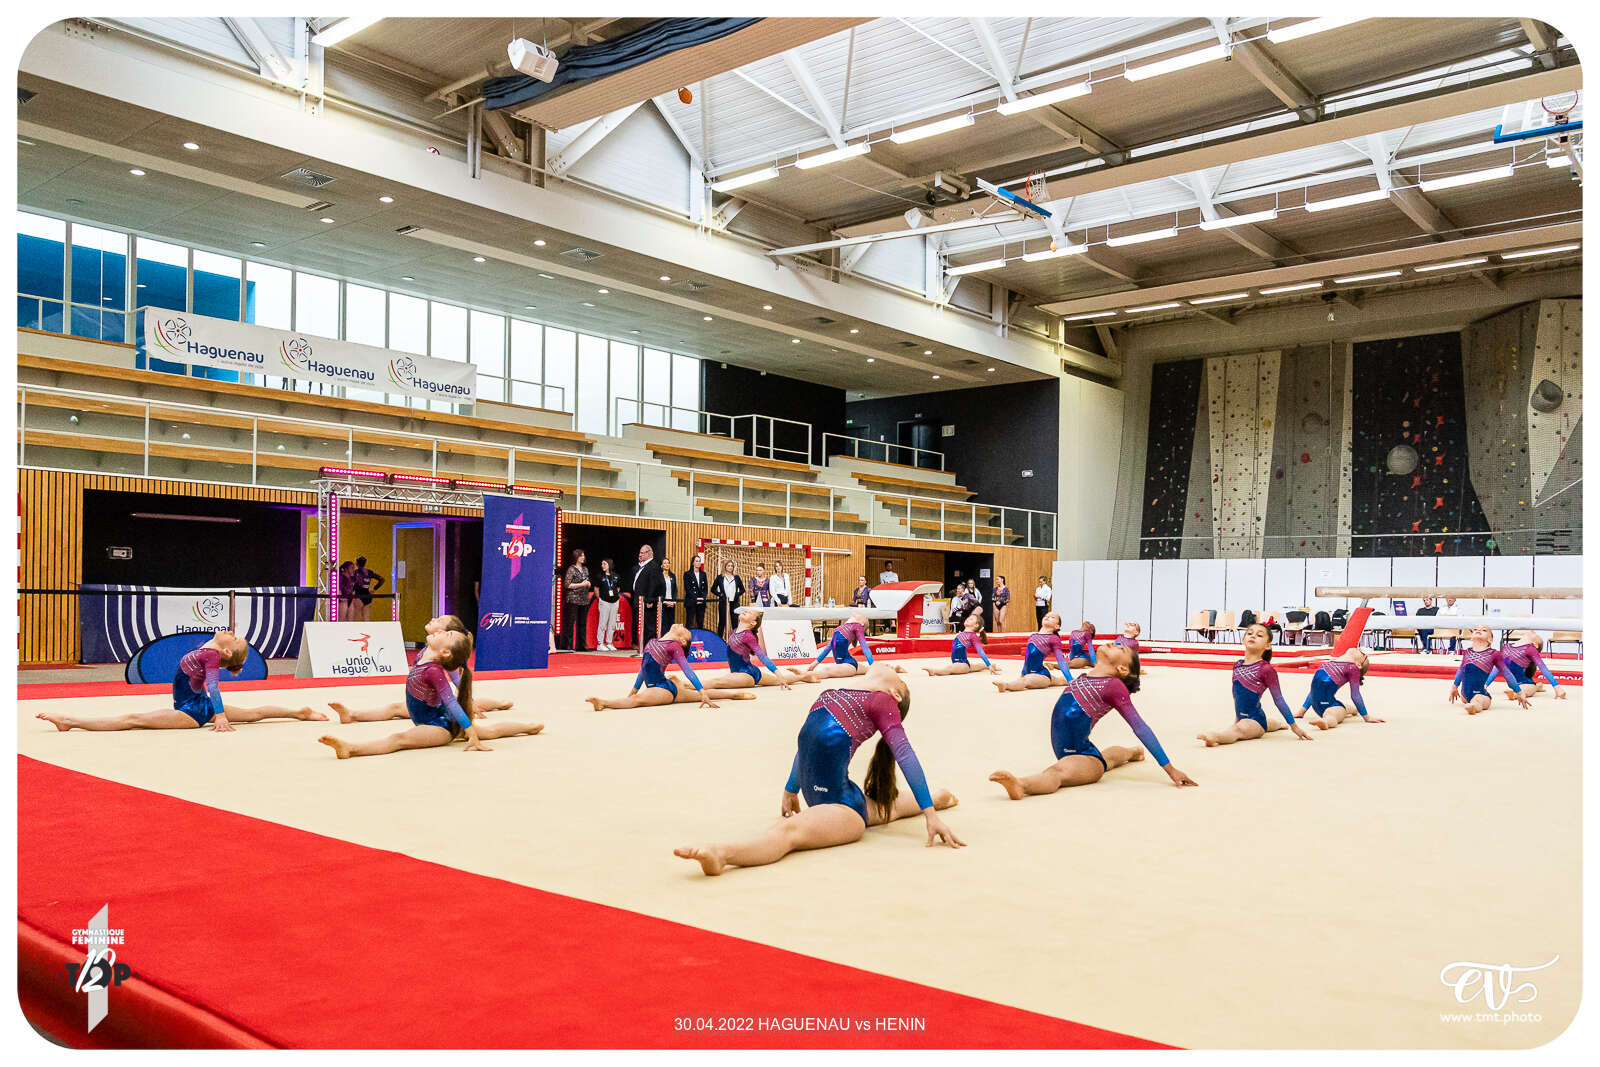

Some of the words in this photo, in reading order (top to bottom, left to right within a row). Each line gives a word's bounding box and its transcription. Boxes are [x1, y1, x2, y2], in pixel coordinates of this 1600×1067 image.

[187, 341, 264, 363] Haguenau
[308, 360, 375, 381] Haguenau
[413, 377, 471, 395] Haguenau
